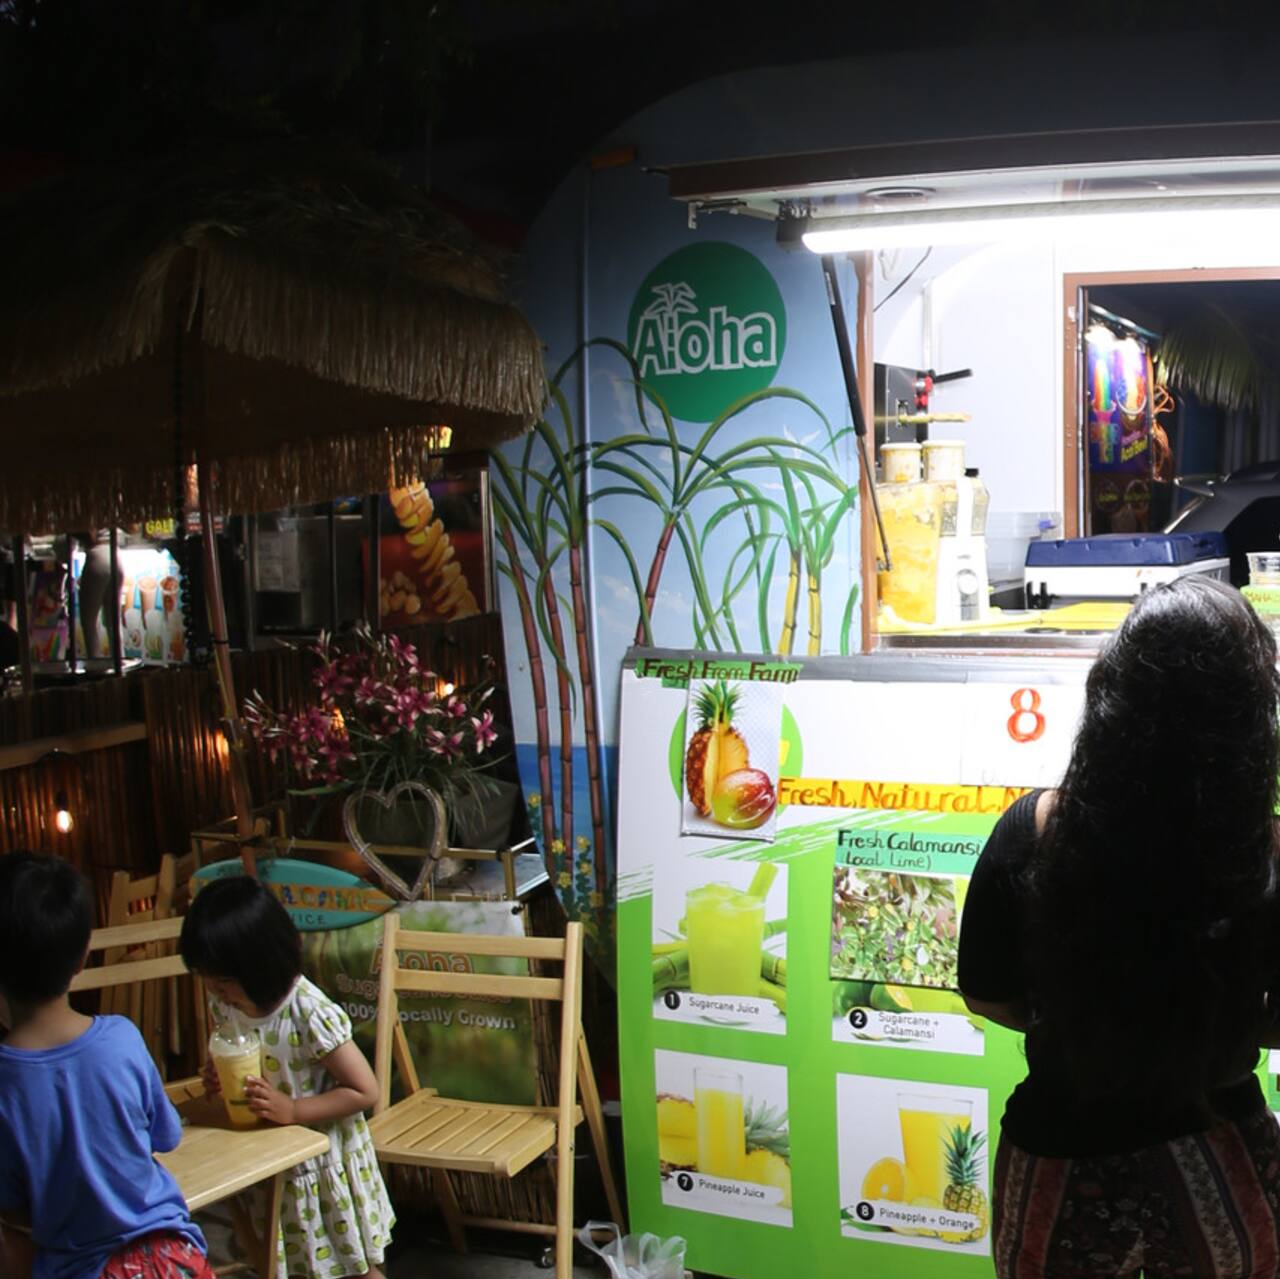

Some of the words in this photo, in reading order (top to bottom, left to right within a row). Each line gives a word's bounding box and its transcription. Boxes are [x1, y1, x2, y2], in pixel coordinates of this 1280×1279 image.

[632, 284, 778, 378] Aloha
[643, 658, 698, 679] Fresh
[702, 660, 745, 680] From
[750, 661, 799, 684] Farm
[1007, 688, 1046, 743] 8
[837, 829, 884, 850] Fresh
[887, 833, 982, 856] Calamansi
[688, 997, 734, 1014] Sugarcane
[736, 1002, 760, 1015] Juice
[399, 1007, 454, 1026] ocally
[458, 1009, 516, 1030] Grown
[878, 1012, 932, 1028] Sugarcane
[883, 1024, 936, 1039] Calamansi
[699, 1179, 741, 1196] Pineapple
[743, 1185, 766, 1200] Juice
[879, 1207, 928, 1225] Pineapple
[939, 1214, 975, 1231] Orange
